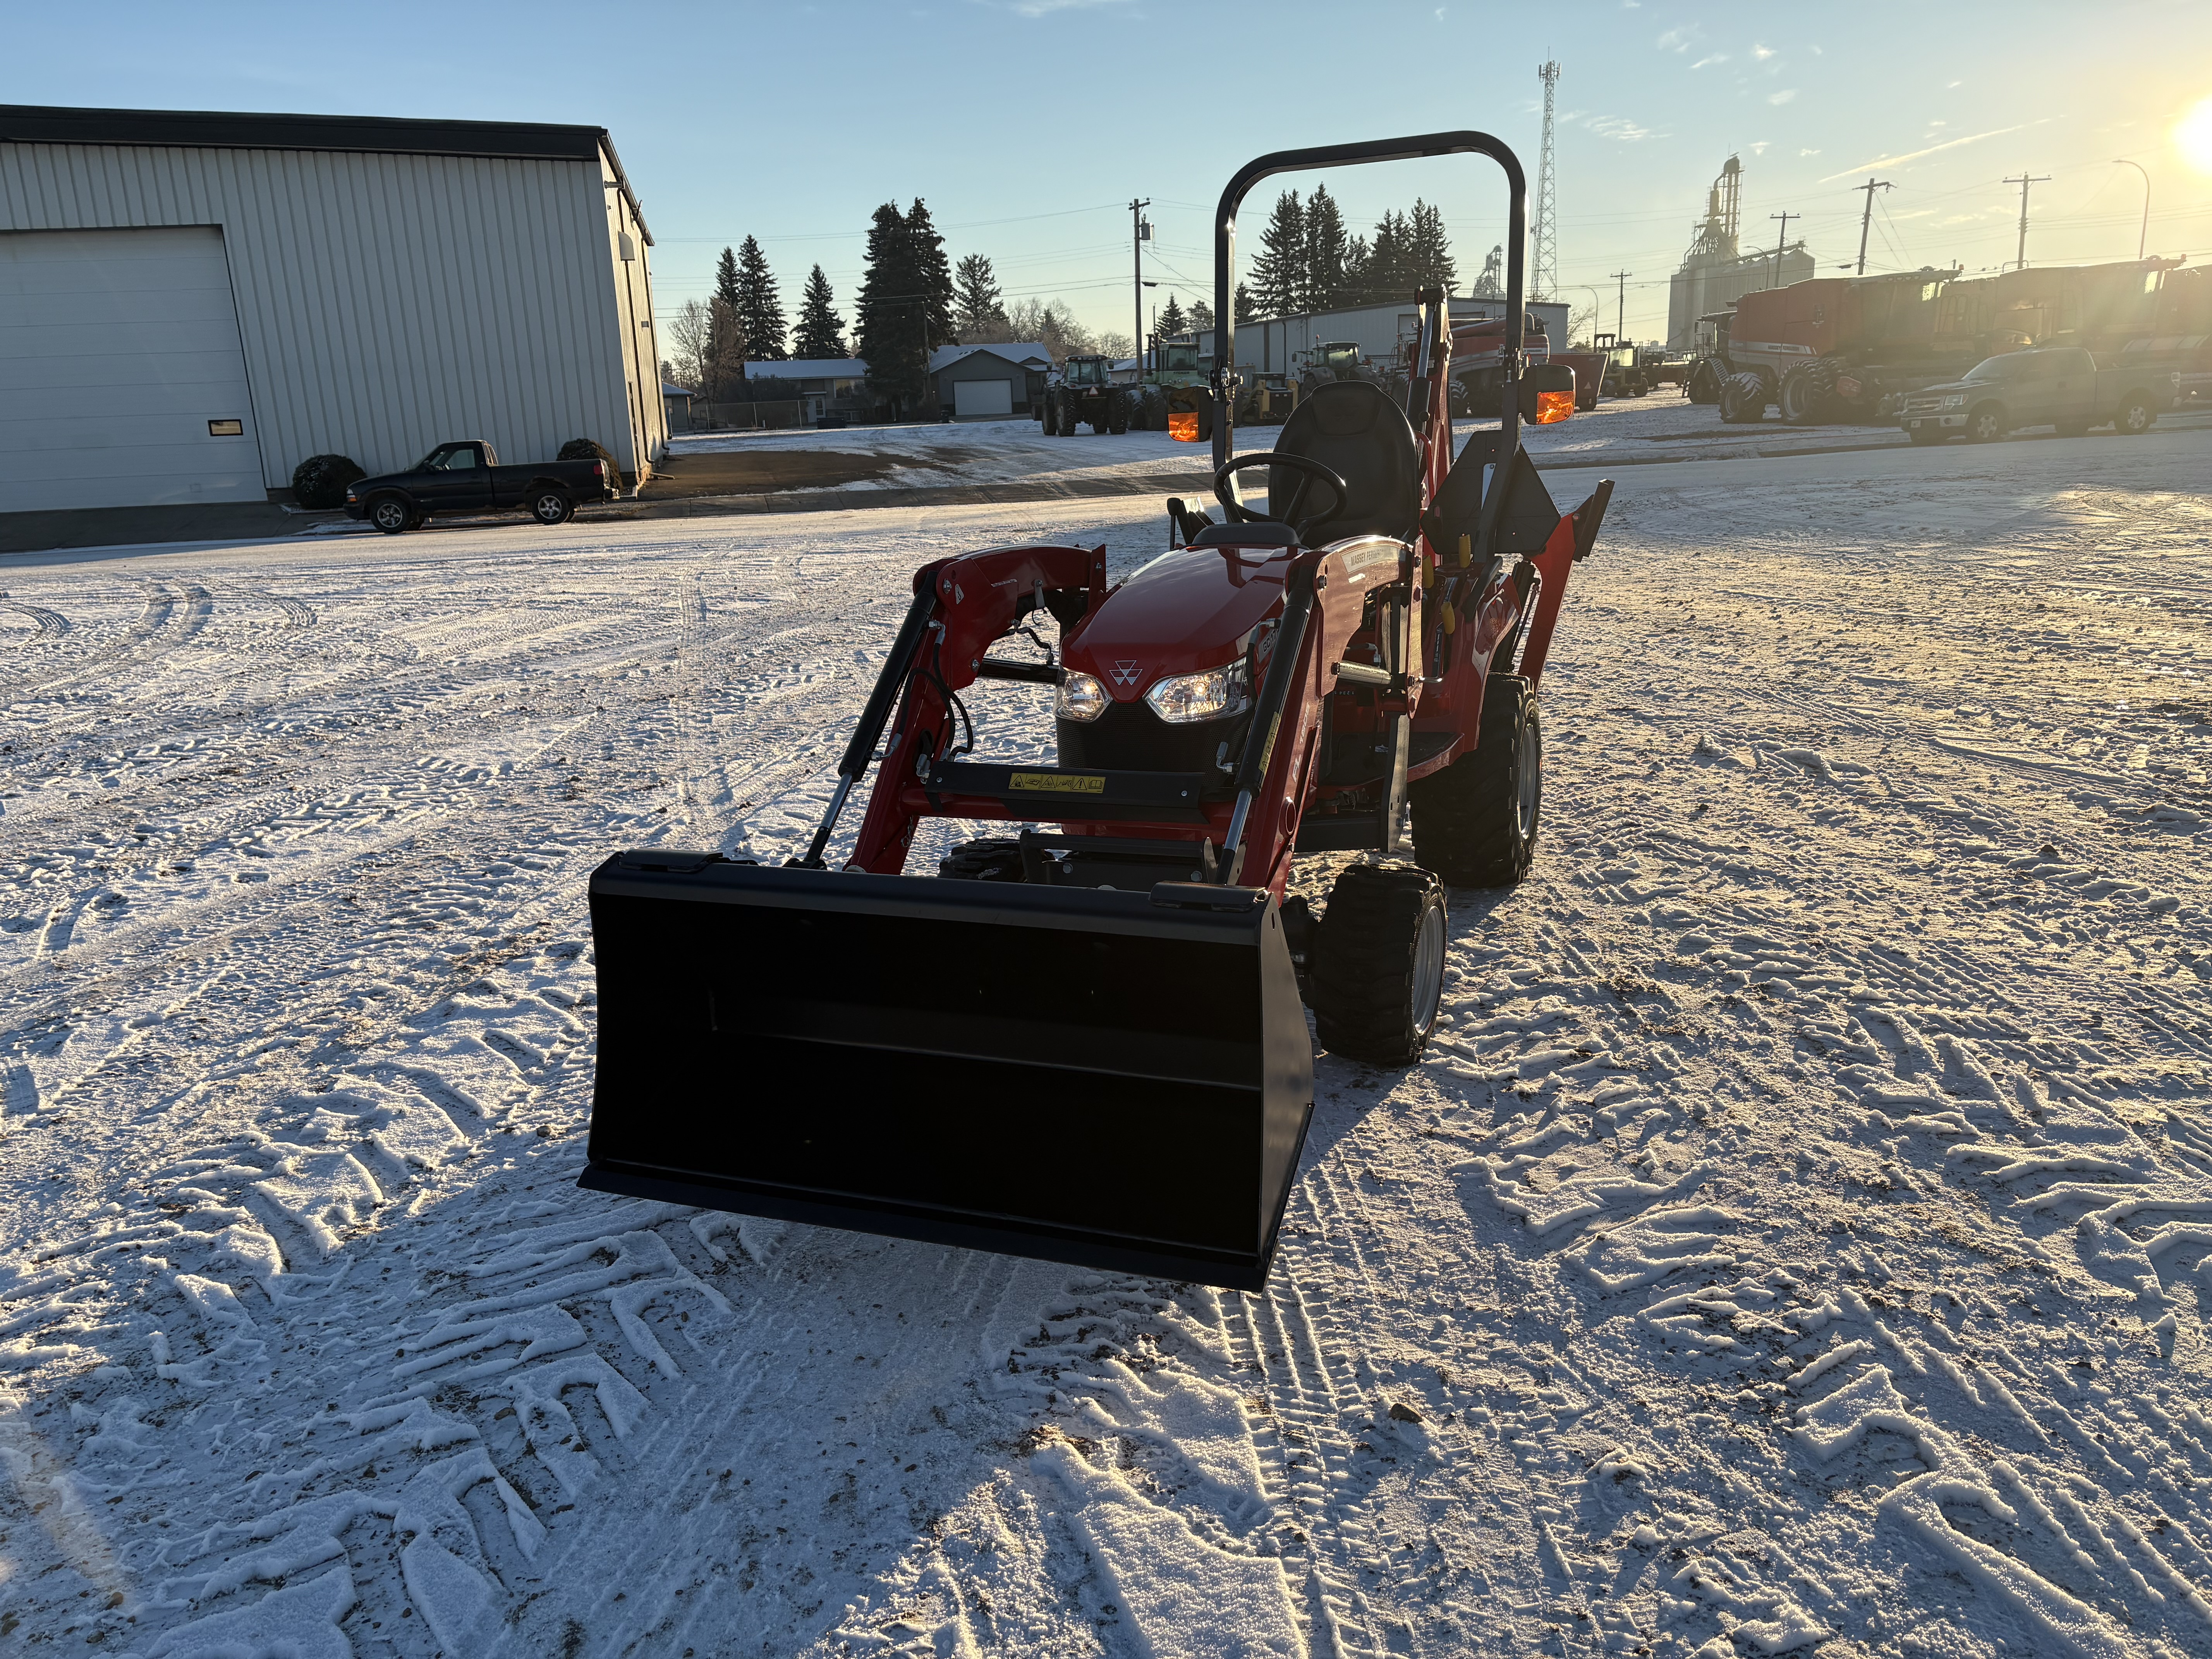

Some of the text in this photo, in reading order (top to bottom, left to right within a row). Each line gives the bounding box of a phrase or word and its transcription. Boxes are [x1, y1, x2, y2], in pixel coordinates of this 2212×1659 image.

[1351, 548, 1385, 567] MASSEY FERGUS
[1292, 702, 1310, 783] FL 1805
